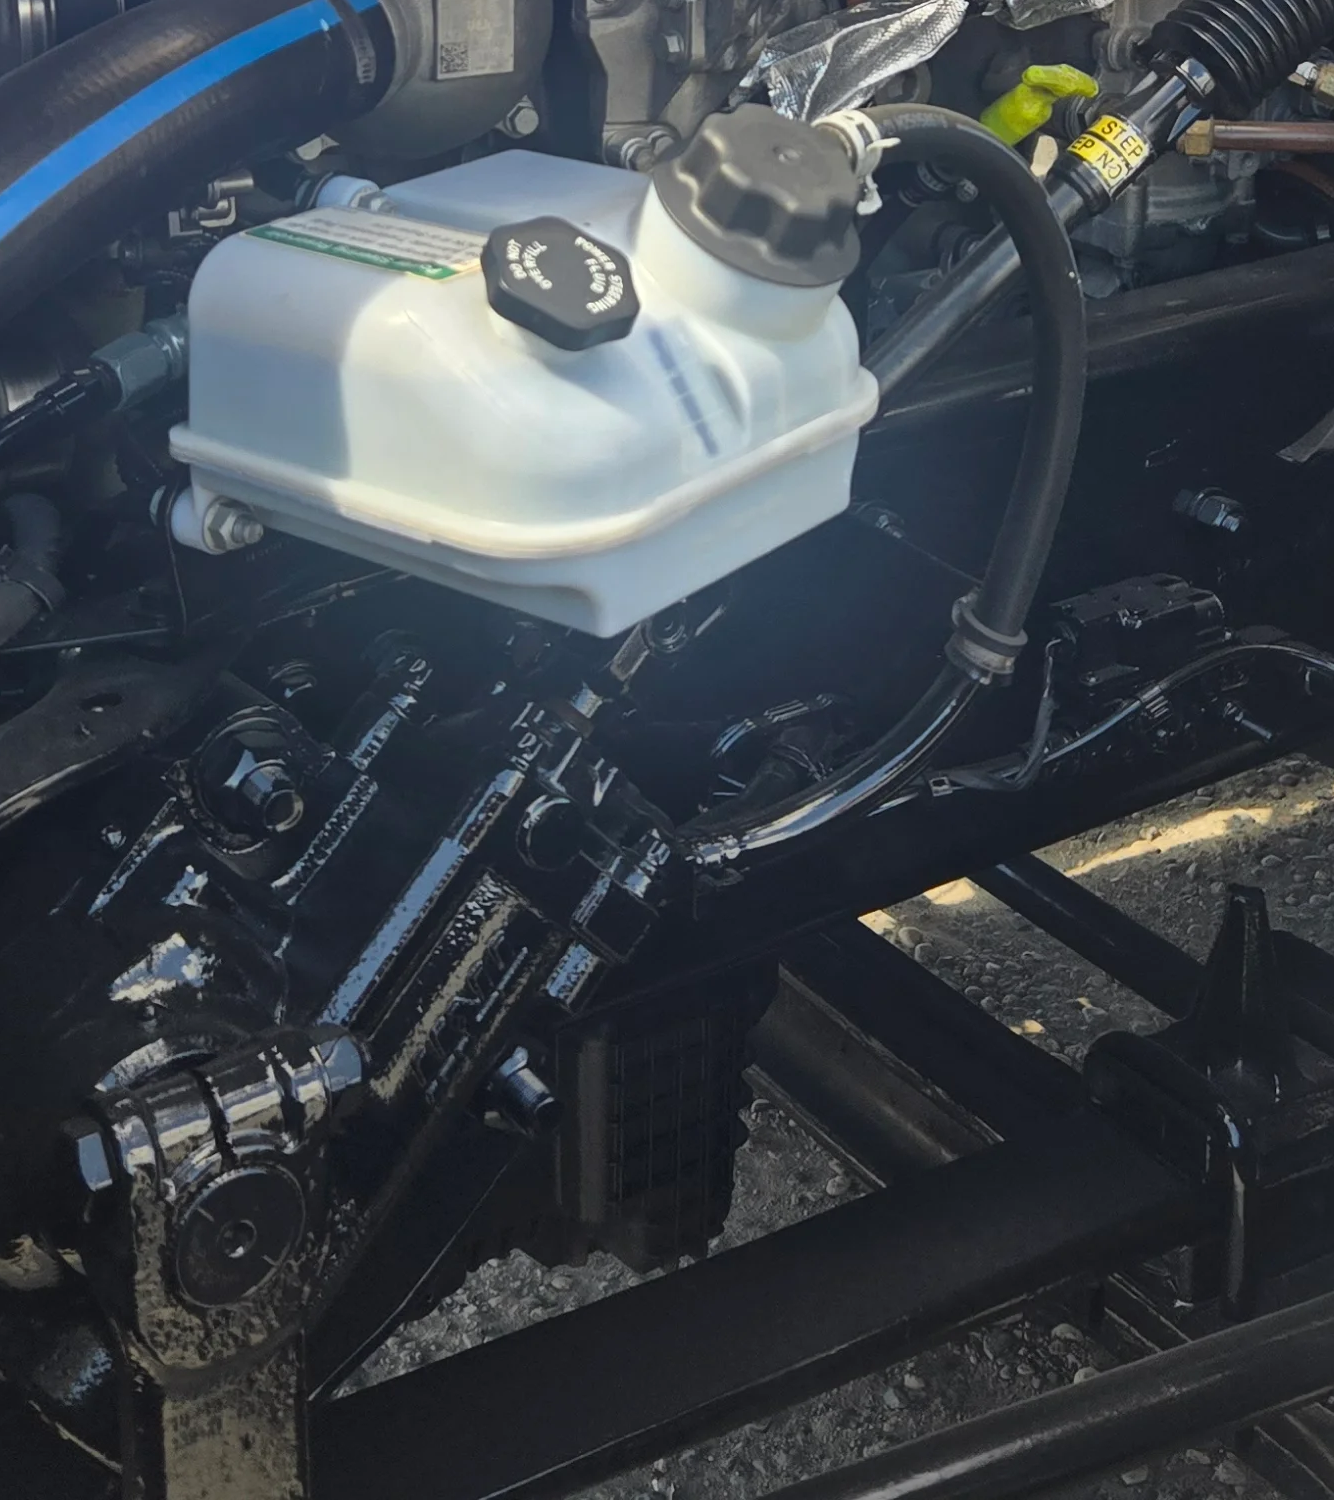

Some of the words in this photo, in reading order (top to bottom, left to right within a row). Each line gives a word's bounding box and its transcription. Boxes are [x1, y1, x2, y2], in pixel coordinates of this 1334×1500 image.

[1101, 120, 1144, 158] STEP
[506, 238, 522, 260] NOT
[522, 240, 553, 290] OVERFILL
[574, 236, 616, 271] POWER
[509, 263, 527, 280] DO
[584, 258, 606, 294] FLUID
[586, 274, 624, 314] STEERING
